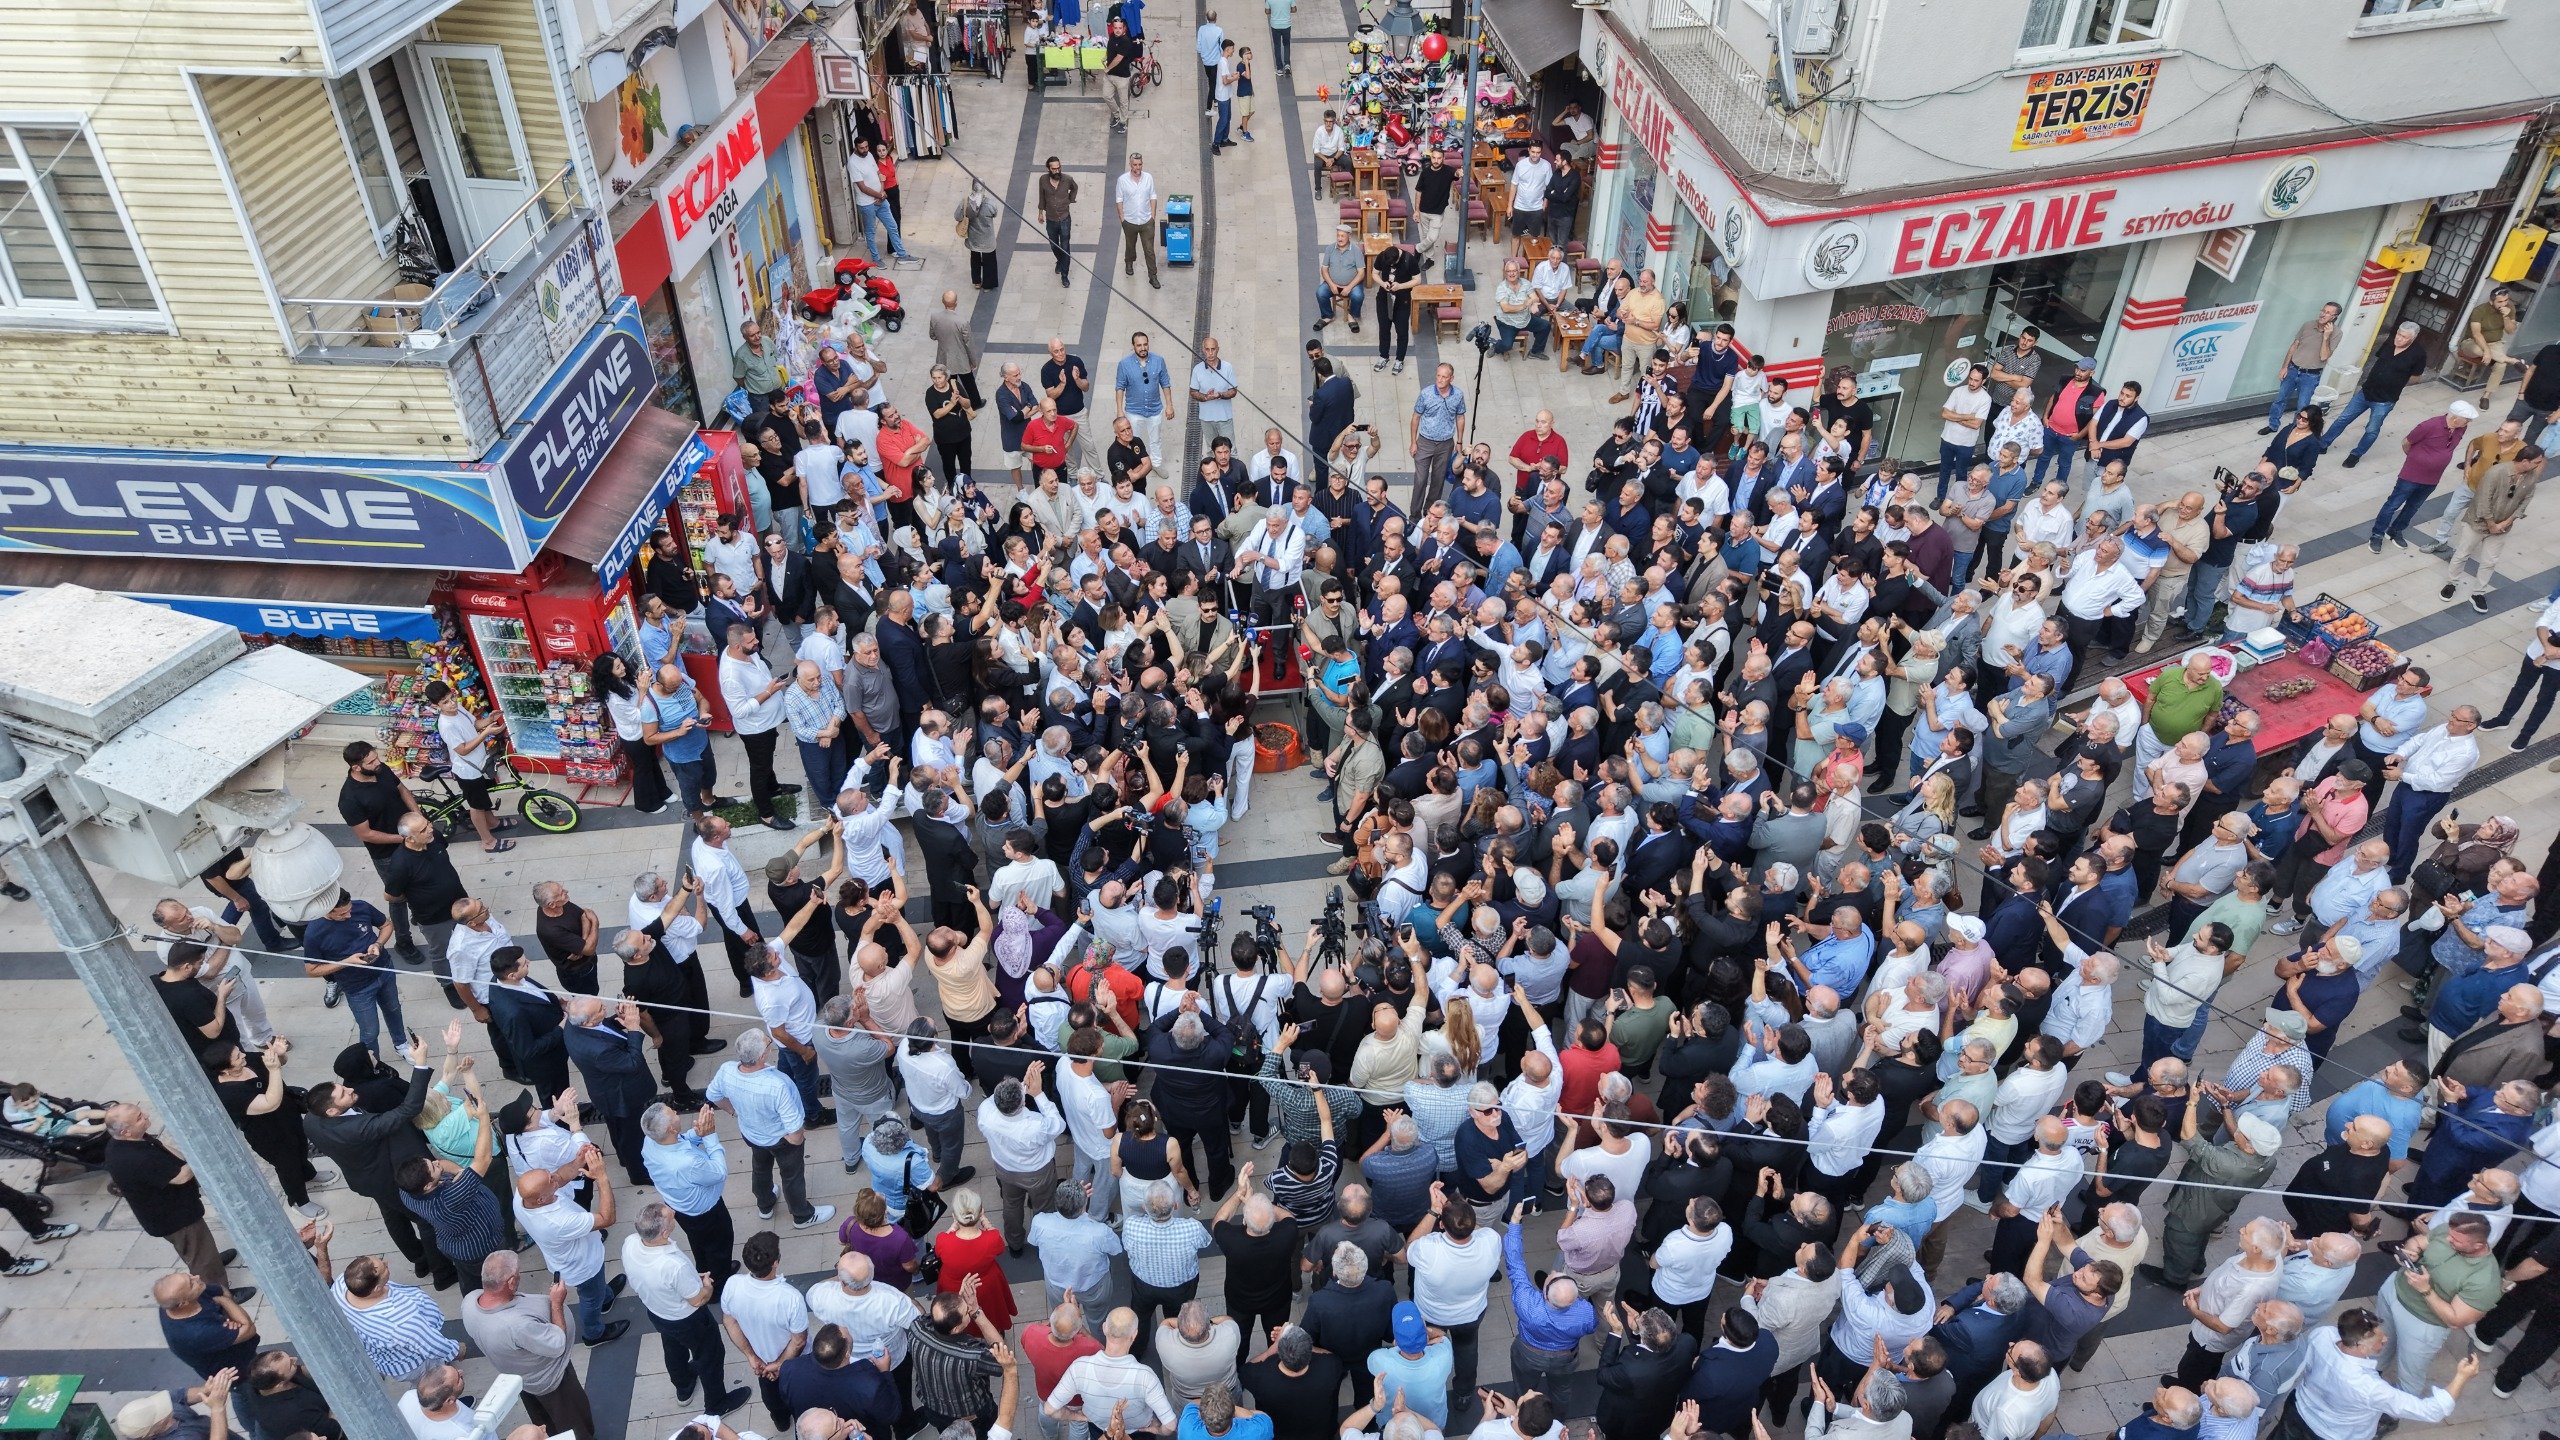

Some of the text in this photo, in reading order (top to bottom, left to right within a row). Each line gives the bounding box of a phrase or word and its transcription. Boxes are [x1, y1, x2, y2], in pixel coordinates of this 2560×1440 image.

[829, 61, 856, 90] E
[2054, 65, 2135, 87] BAY-BAYAN
[1613, 54, 1675, 176] ECZANE
[2026, 80, 2149, 130] TERZİSİ
[668, 108, 761, 243] ECZANE
[708, 189, 739, 236] DOĞA
[1676, 169, 1717, 232] SEYİTOĞLU
[1891, 188, 2235, 275] ECZANE SEYİTOĞLU
[2212, 227, 2238, 266] E
[1826, 305, 1879, 336] EYİTOĞLU
[1878, 303, 1931, 325] ECZANESİ
[2217, 303, 2259, 320] ECZANESİ
[2178, 335, 2223, 358] SGK
[2174, 378, 2197, 401] E
[529, 338, 632, 493] PLEVNE
[576, 420, 610, 471] BÜFE
[0, 476, 420, 531] PLEVNE
[605, 443, 705, 586] PLEVNE BÜFE
[148, 523, 286, 549] BÜFE
[258, 608, 381, 634] BÜFE
[471, 594, 507, 608] Coca-Cola
